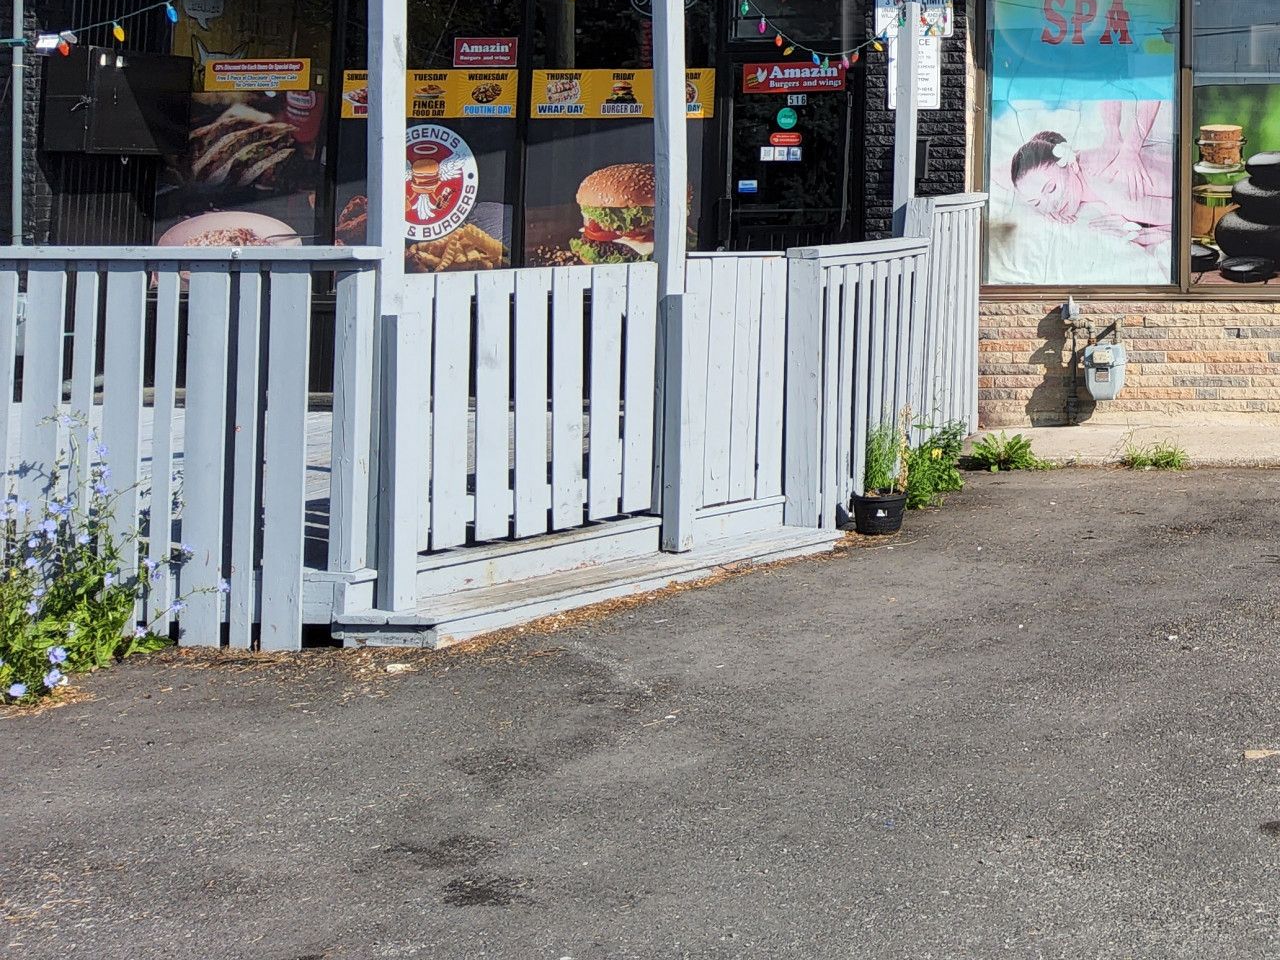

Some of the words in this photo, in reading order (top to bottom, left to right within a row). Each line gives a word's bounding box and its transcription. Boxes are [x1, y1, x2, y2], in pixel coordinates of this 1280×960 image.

[460, 42, 512, 52] Amazin'
[769, 64, 842, 79] Amazin'
[413, 73, 448, 81] TUESDAY
[467, 73, 509, 81] WEDNESDAY
[769, 80, 800, 88] Burgers
[819, 79, 842, 87] wings
[789, 95, 806, 104] 516
[413, 100, 445, 109] FINGER
[538, 105, 566, 113] WRAP
[567, 104, 584, 113] DAY
[602, 105, 628, 113] BURGER
[630, 105, 642, 113] DAY
[464, 105, 496, 115] POUTINE
[497, 105, 512, 114] DAY
[422, 185, 475, 238] BURGERS
[407, 226, 416, 237] &
